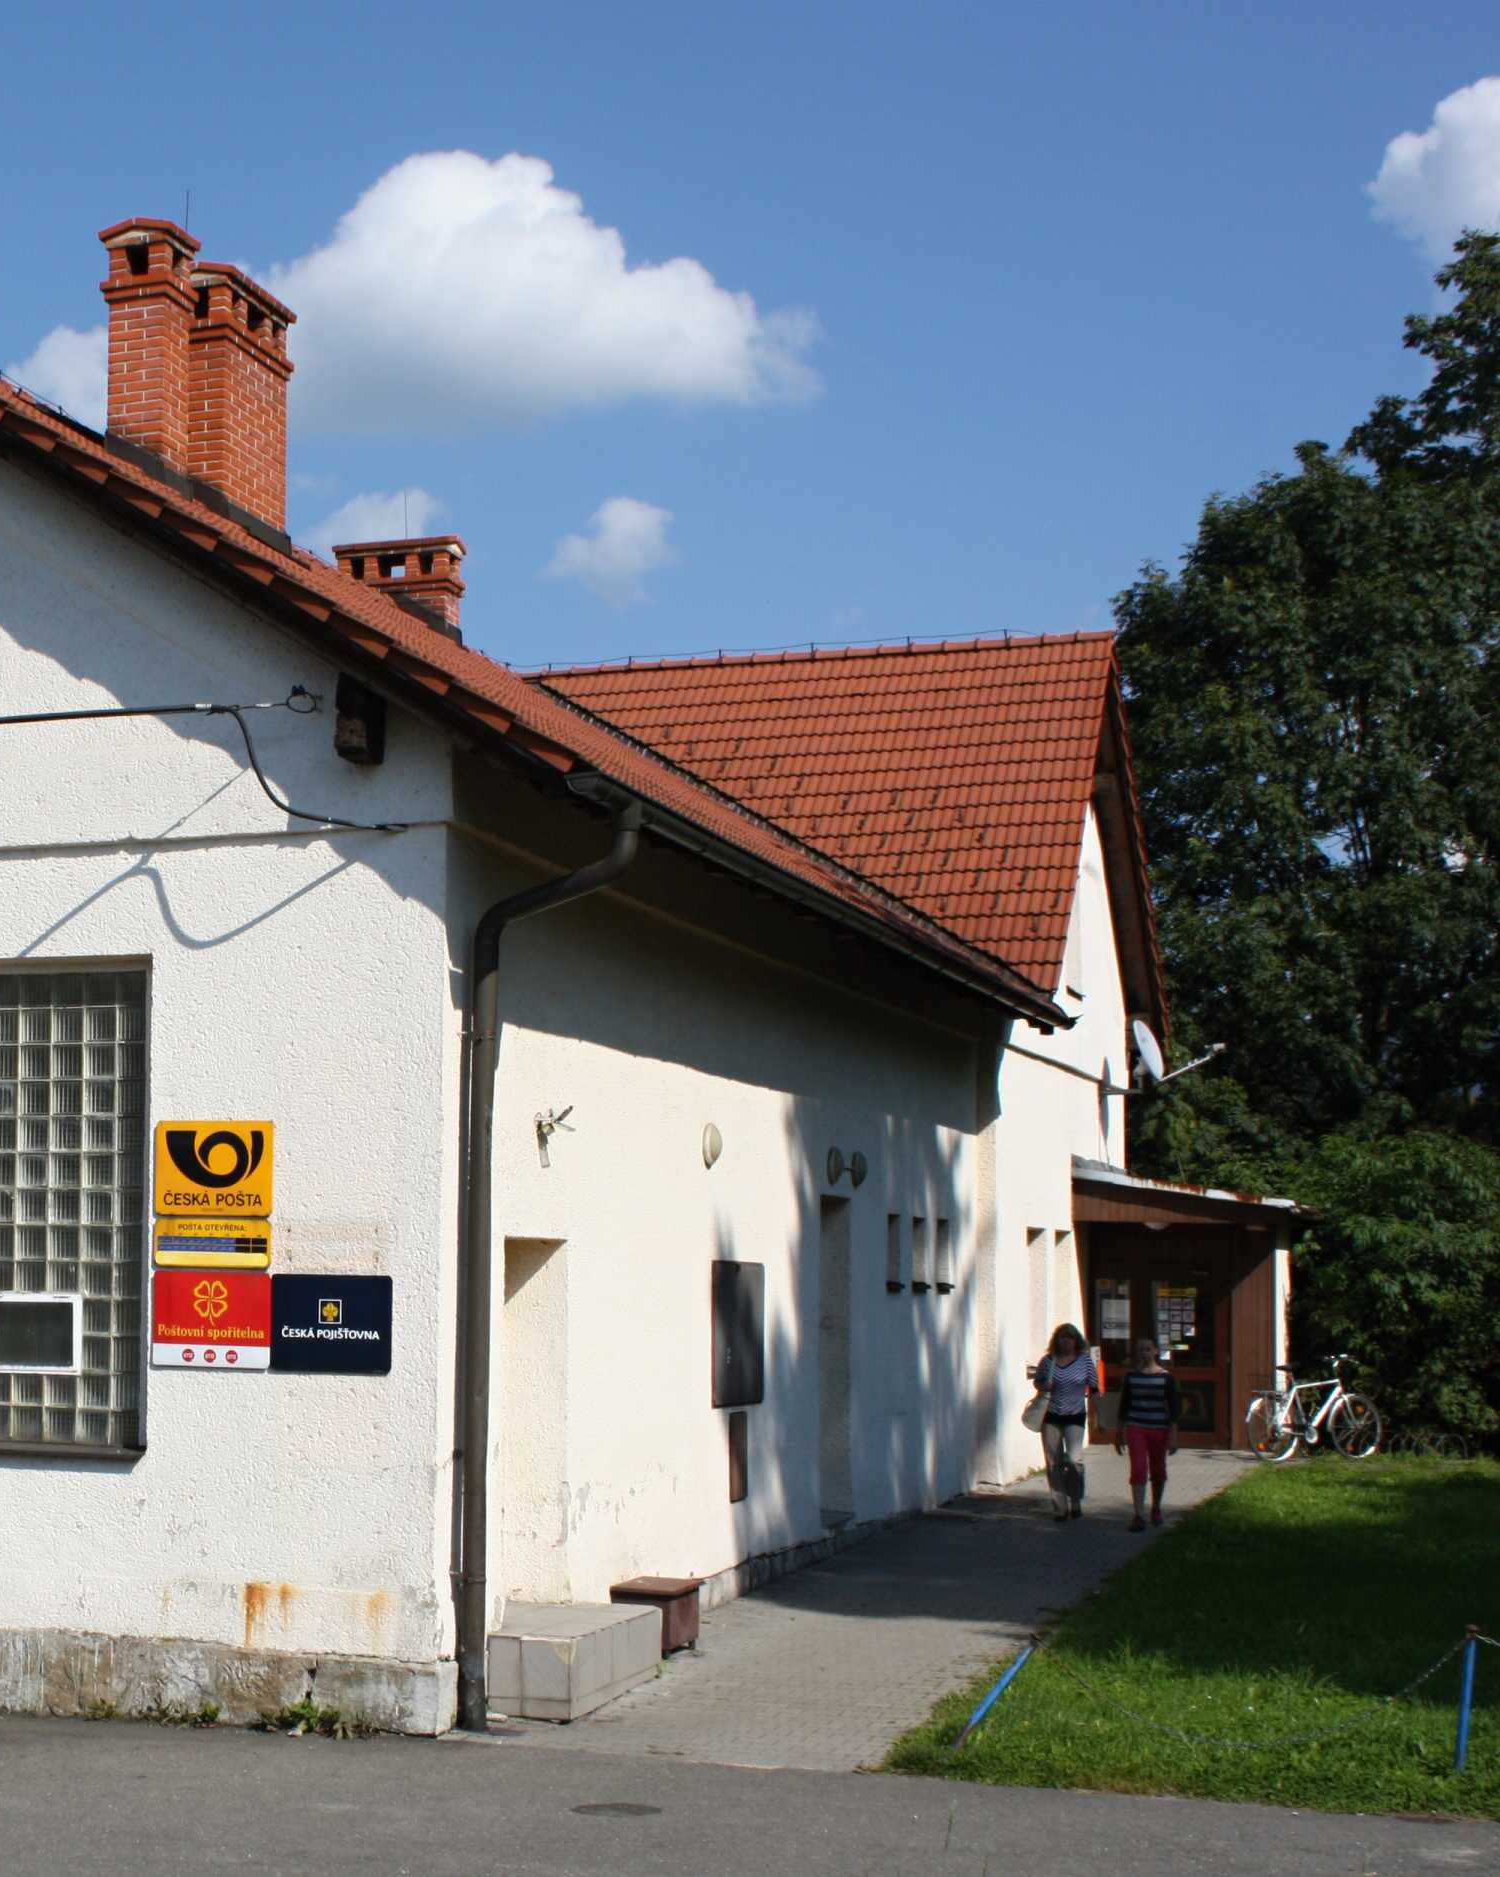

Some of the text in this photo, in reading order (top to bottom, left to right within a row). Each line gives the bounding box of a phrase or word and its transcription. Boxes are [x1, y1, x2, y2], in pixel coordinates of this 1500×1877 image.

[163, 1190, 262, 1207] ČESKÁ POŠTA
[158, 1324, 265, 1340] Poštovní spořitelna
[281, 1325, 380, 1340] ČESKÁ POJIŠŤOVNA
